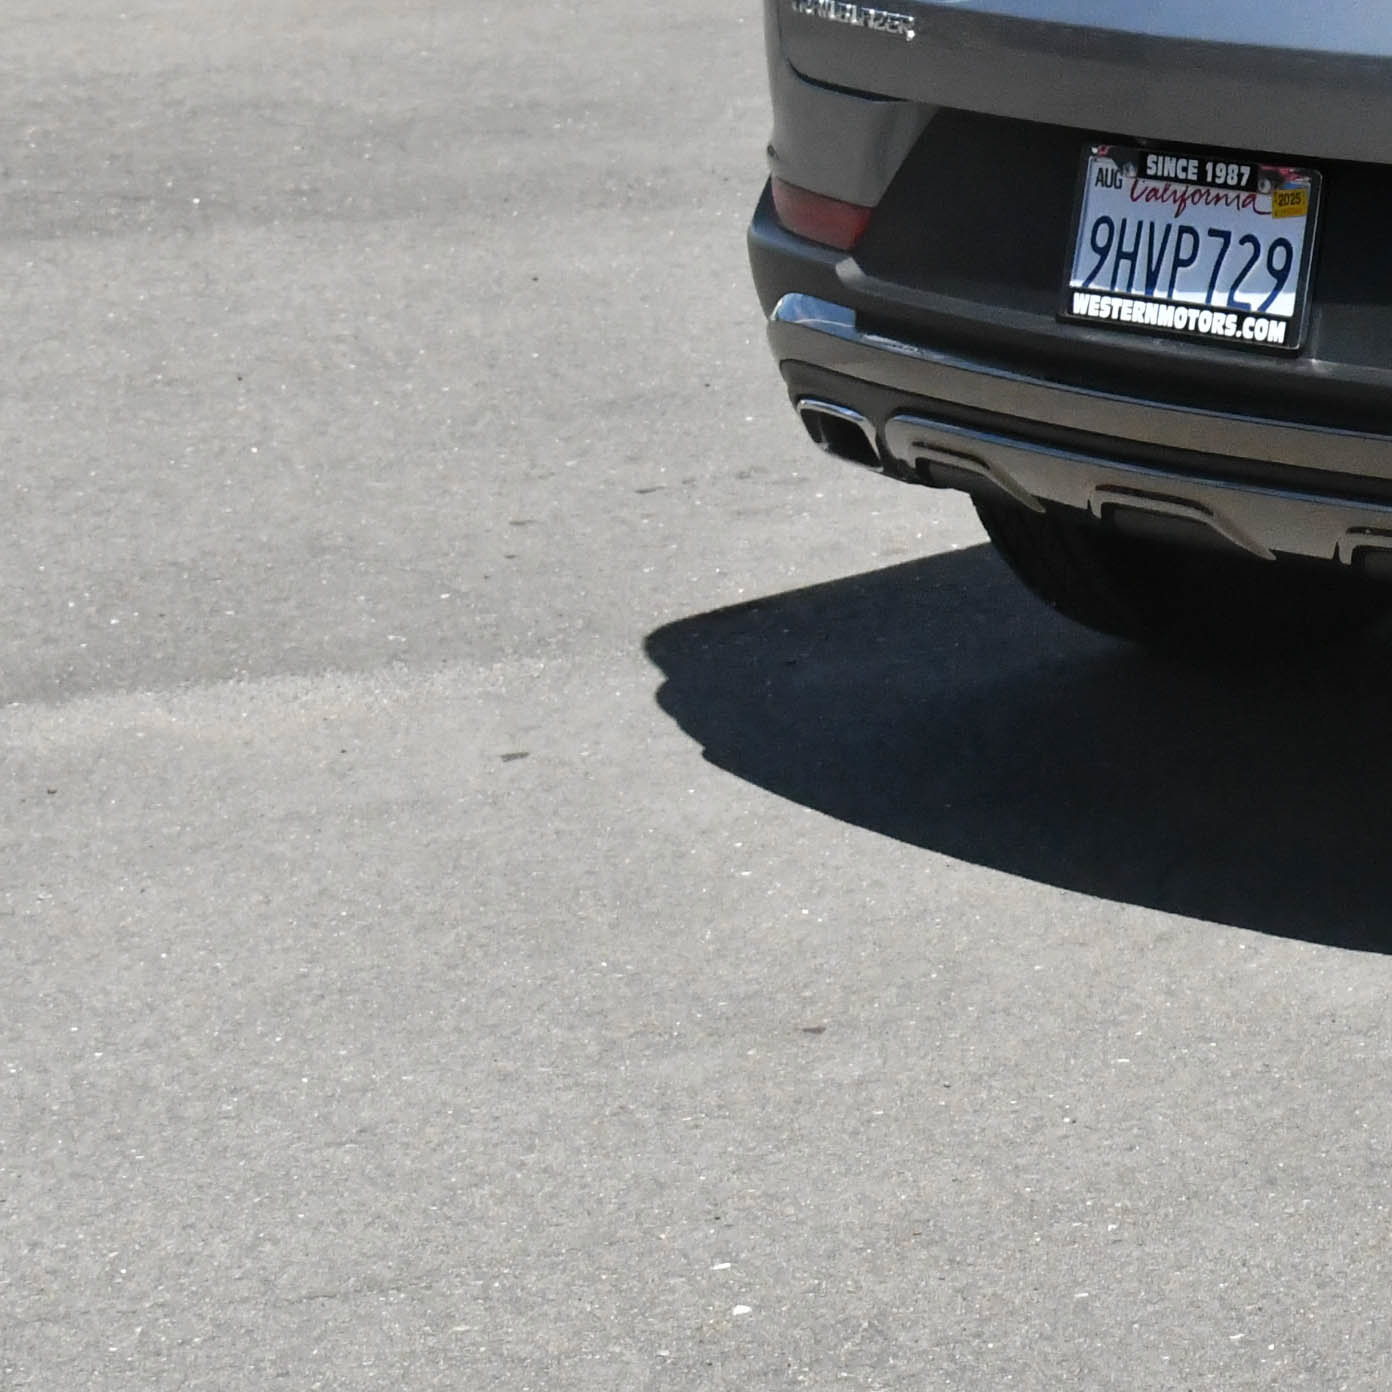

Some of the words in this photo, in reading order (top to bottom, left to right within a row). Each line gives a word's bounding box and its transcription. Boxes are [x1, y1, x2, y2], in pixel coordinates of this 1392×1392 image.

[1094, 167, 1123, 190] AUG
[1146, 154, 1199, 181] SINCE
[1205, 162, 1251, 187] 1987
[1130, 178, 1272, 218] California
[1277, 191, 1302, 207] 2025
[1082, 215, 1293, 313] 9HVP729
[1072, 292, 1287, 344] WESTERNMOTORS.COM
